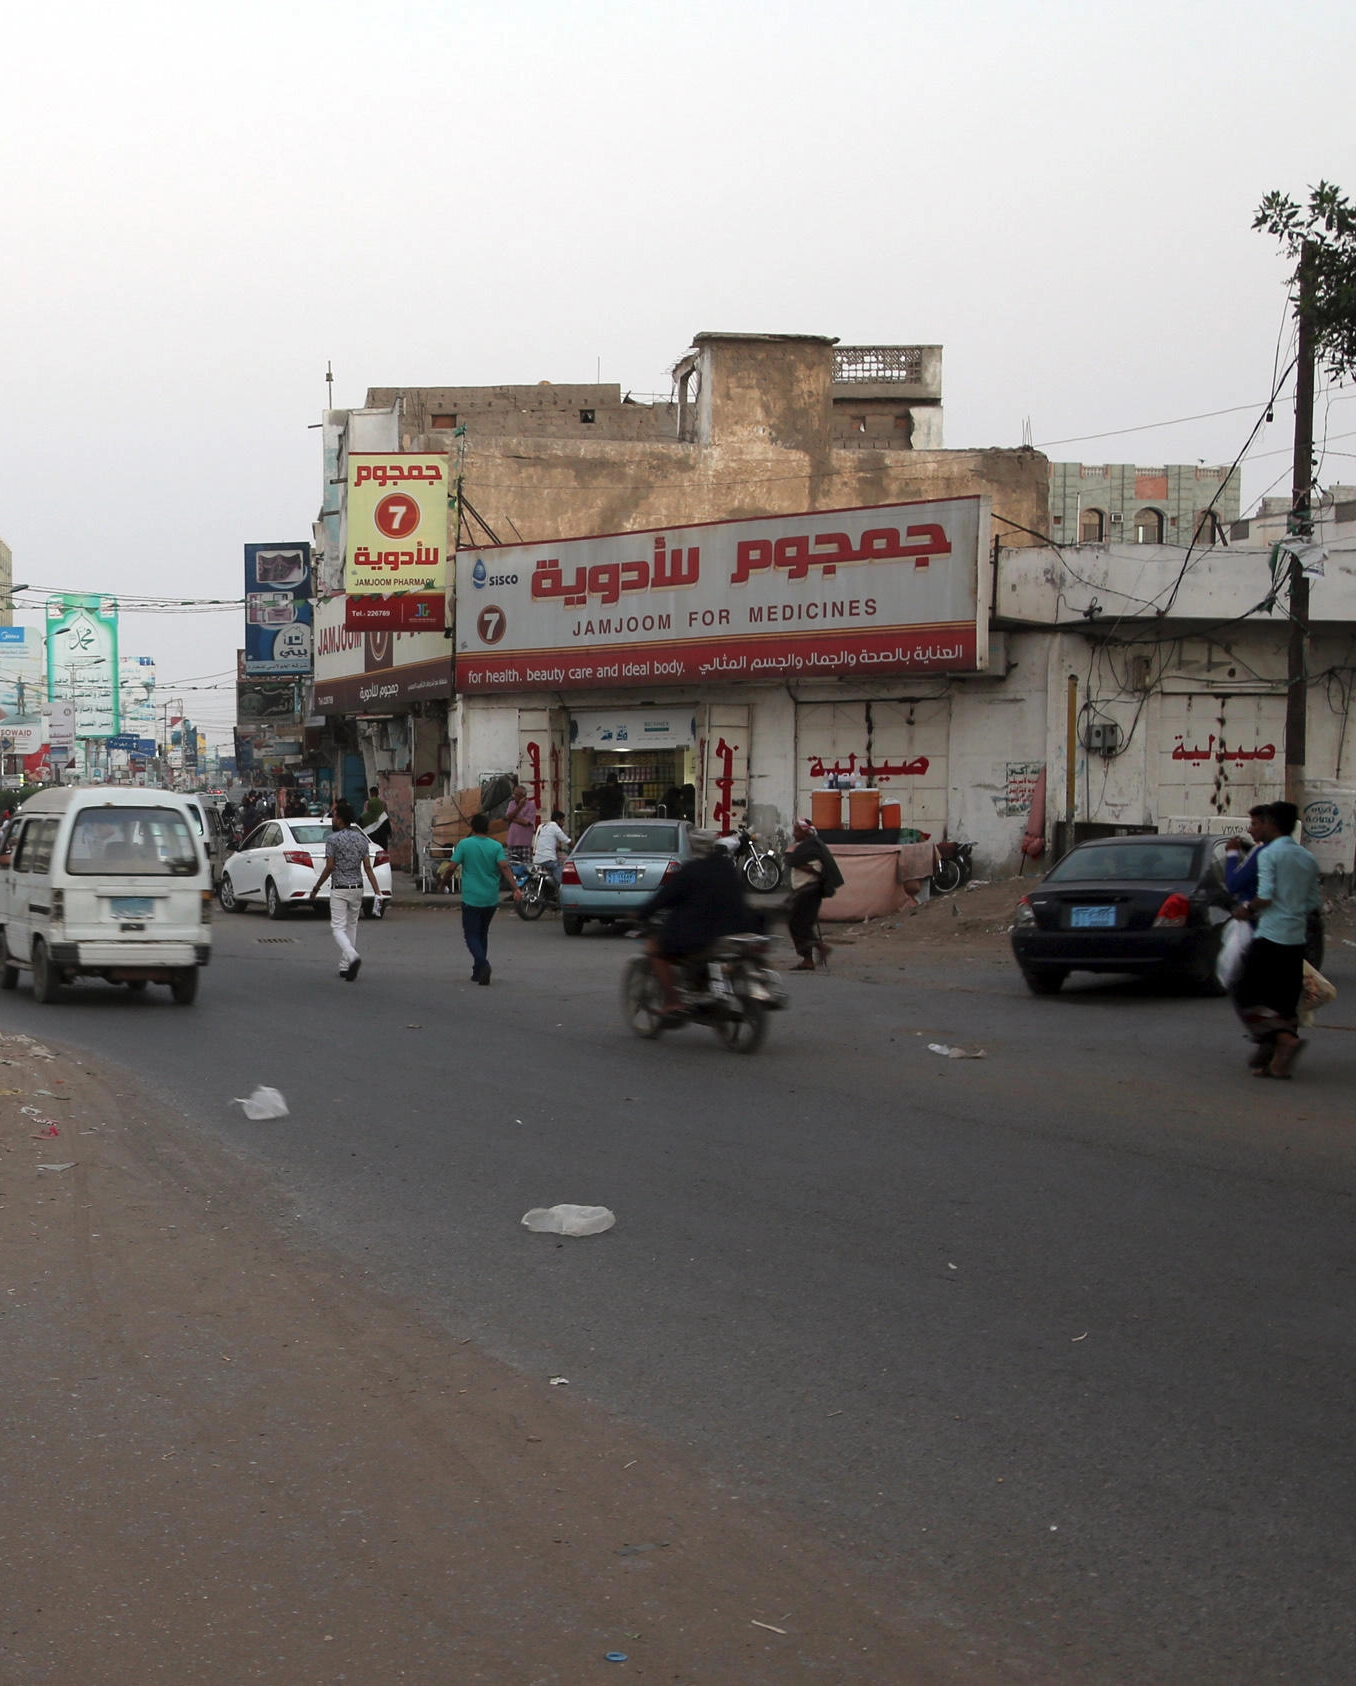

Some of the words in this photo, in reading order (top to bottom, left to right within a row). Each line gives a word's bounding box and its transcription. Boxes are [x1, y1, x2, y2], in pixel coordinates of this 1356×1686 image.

[354, 464, 442, 487] جمجوم
[388, 505, 407, 530] 7
[354, 541, 439, 571] للأدوية
[731, 523, 952, 585] جمجوم
[355, 578, 392, 586] JAMJOOM
[531, 537, 700, 609] للأدوية
[483, 612, 500, 640] 7
[573, 614, 671, 637] JAMJOOM
[688, 608, 731, 627] FOR
[749, 598, 878, 623] MEDICINES
[699, 653, 747, 675] المثالي
[750, 654, 804, 672] والجسم
[805, 650, 857, 667] والجمال
[859, 647, 911, 665] بالصحة
[914, 644, 963, 661] العناية
[468, 670, 483, 684] for
[526, 666, 565, 684] beauty
[568, 666, 593, 680] care
[596, 663, 619, 678] and
[653, 659, 686, 676] body.
[0, 729, 32, 737] SOWAID
[1172, 734, 1276, 768] صيدلية
[807, 752, 930, 782] صيدلية
